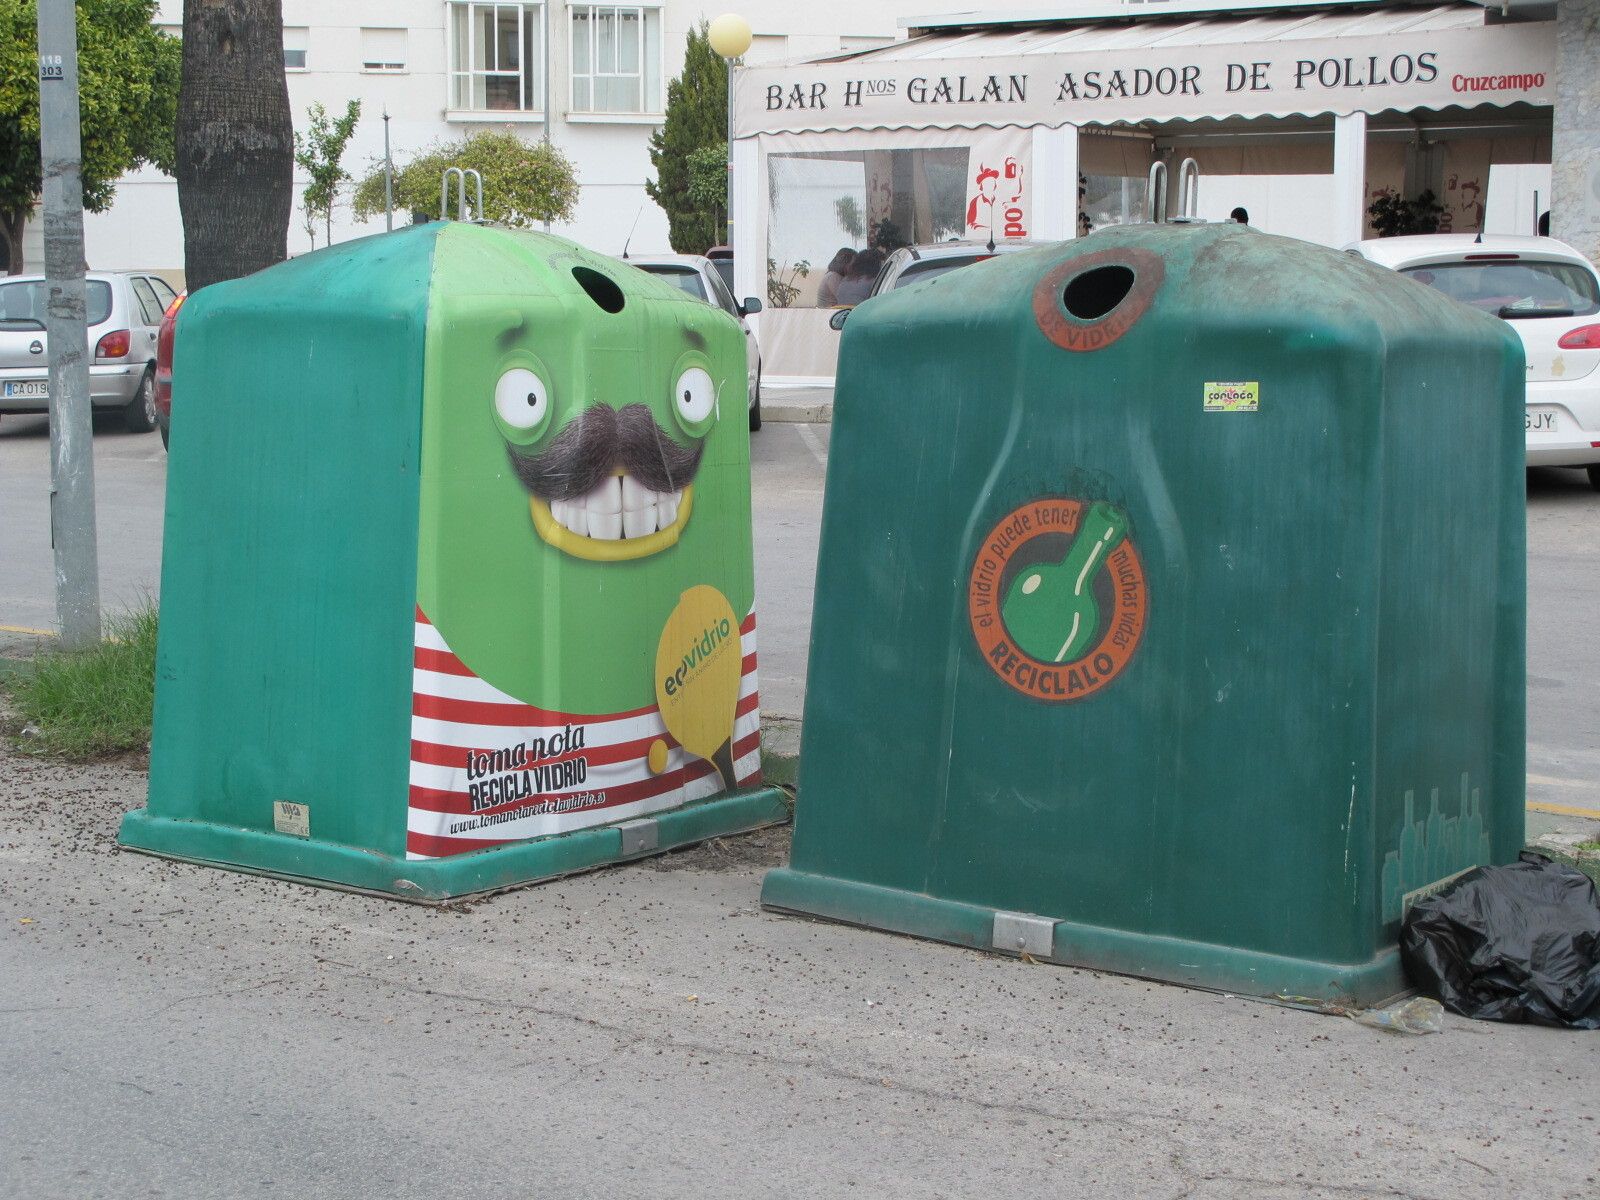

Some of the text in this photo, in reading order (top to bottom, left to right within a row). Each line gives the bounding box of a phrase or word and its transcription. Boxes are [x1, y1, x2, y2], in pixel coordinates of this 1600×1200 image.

[41, 55, 62, 65] 118
[41, 66, 63, 76] 303
[766, 82, 828, 111] BAR
[906, 74, 1029, 104] GALAN
[1056, 65, 1204, 101] ASADOR
[1225, 62, 1273, 93] DE
[1293, 52, 1440, 90] POLLOS
[1451, 71, 1546, 93] Cruzcampo
[1004, 207, 1027, 239] po
[27, 383, 49, 394] 019
[972, 505, 1142, 651] el vidrio puede tener muchas vidas
[664, 618, 730, 696] ecovidrio
[989, 641, 1114, 696] RECICLALO
[466, 723, 586, 781] toma nota
[468, 757, 588, 812] RECICLA VIDRIO
